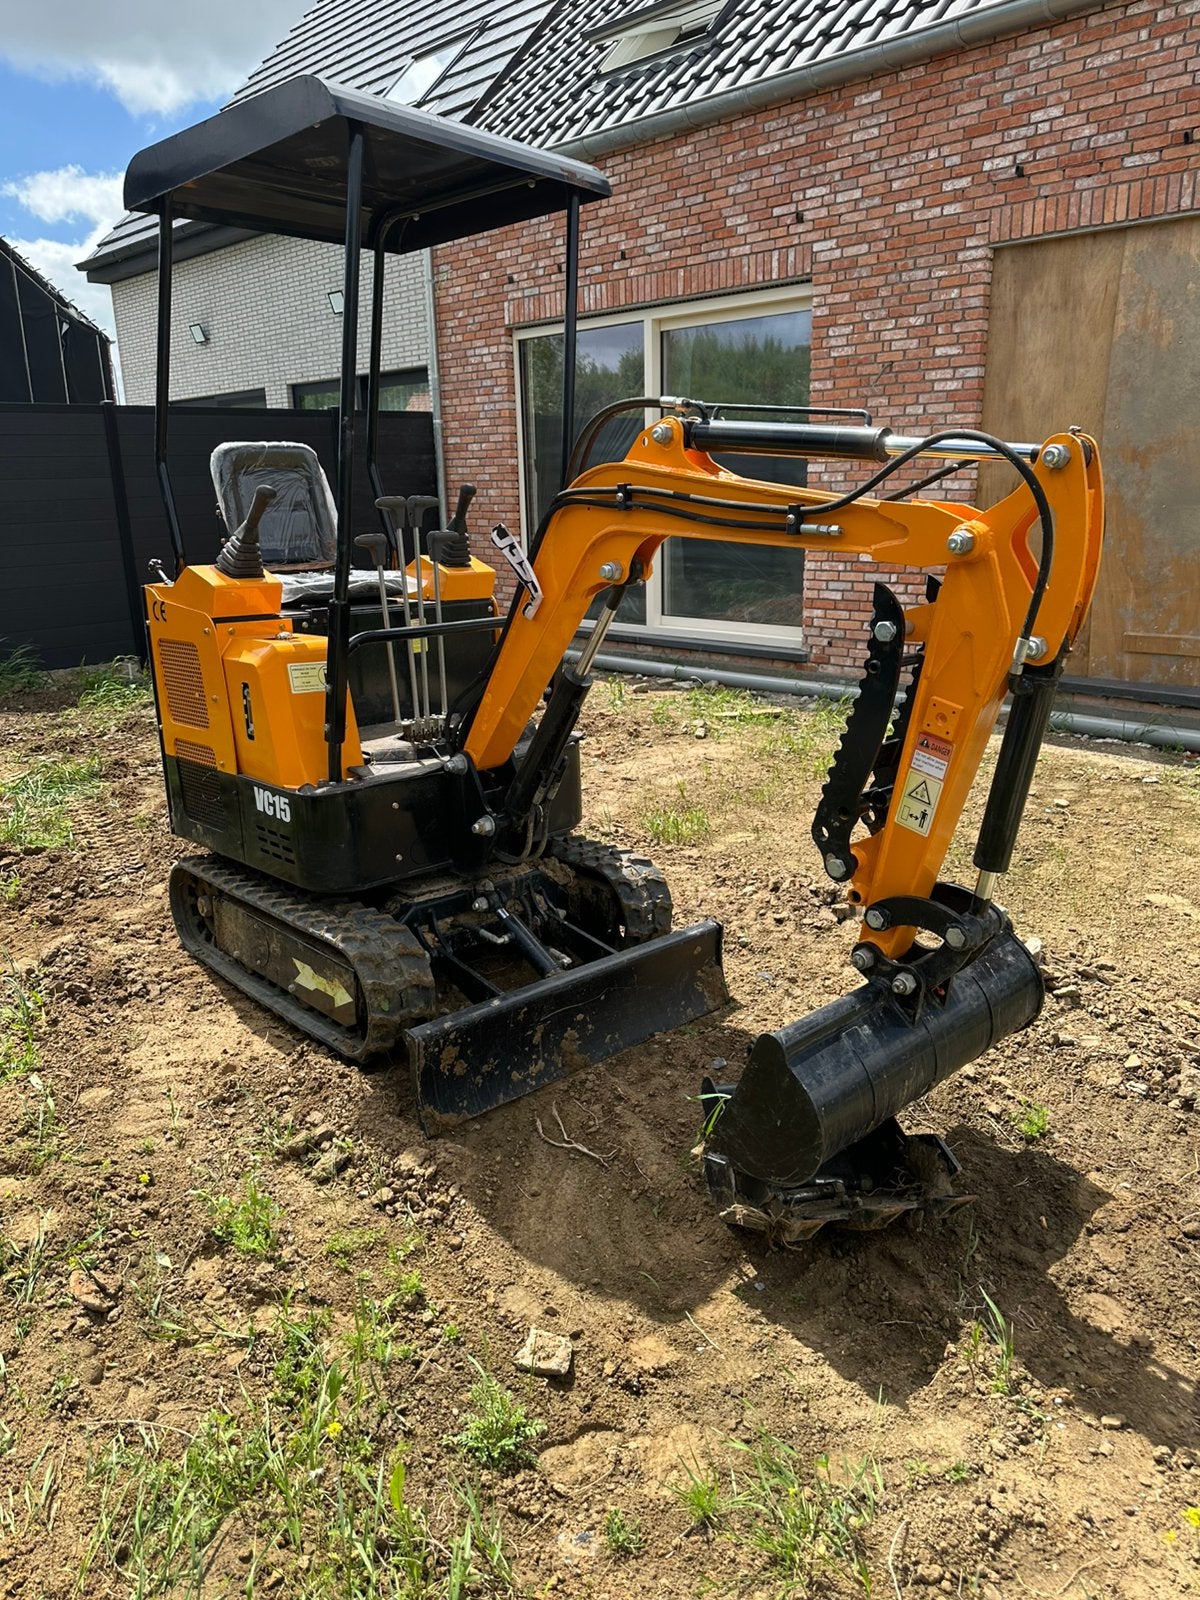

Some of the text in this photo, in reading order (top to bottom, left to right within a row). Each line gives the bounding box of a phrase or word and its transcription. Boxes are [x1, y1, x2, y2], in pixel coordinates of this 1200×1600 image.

[152, 600, 167, 622] CE
[930, 743, 950, 756] DANGER
[253, 786, 291, 823] VC15
